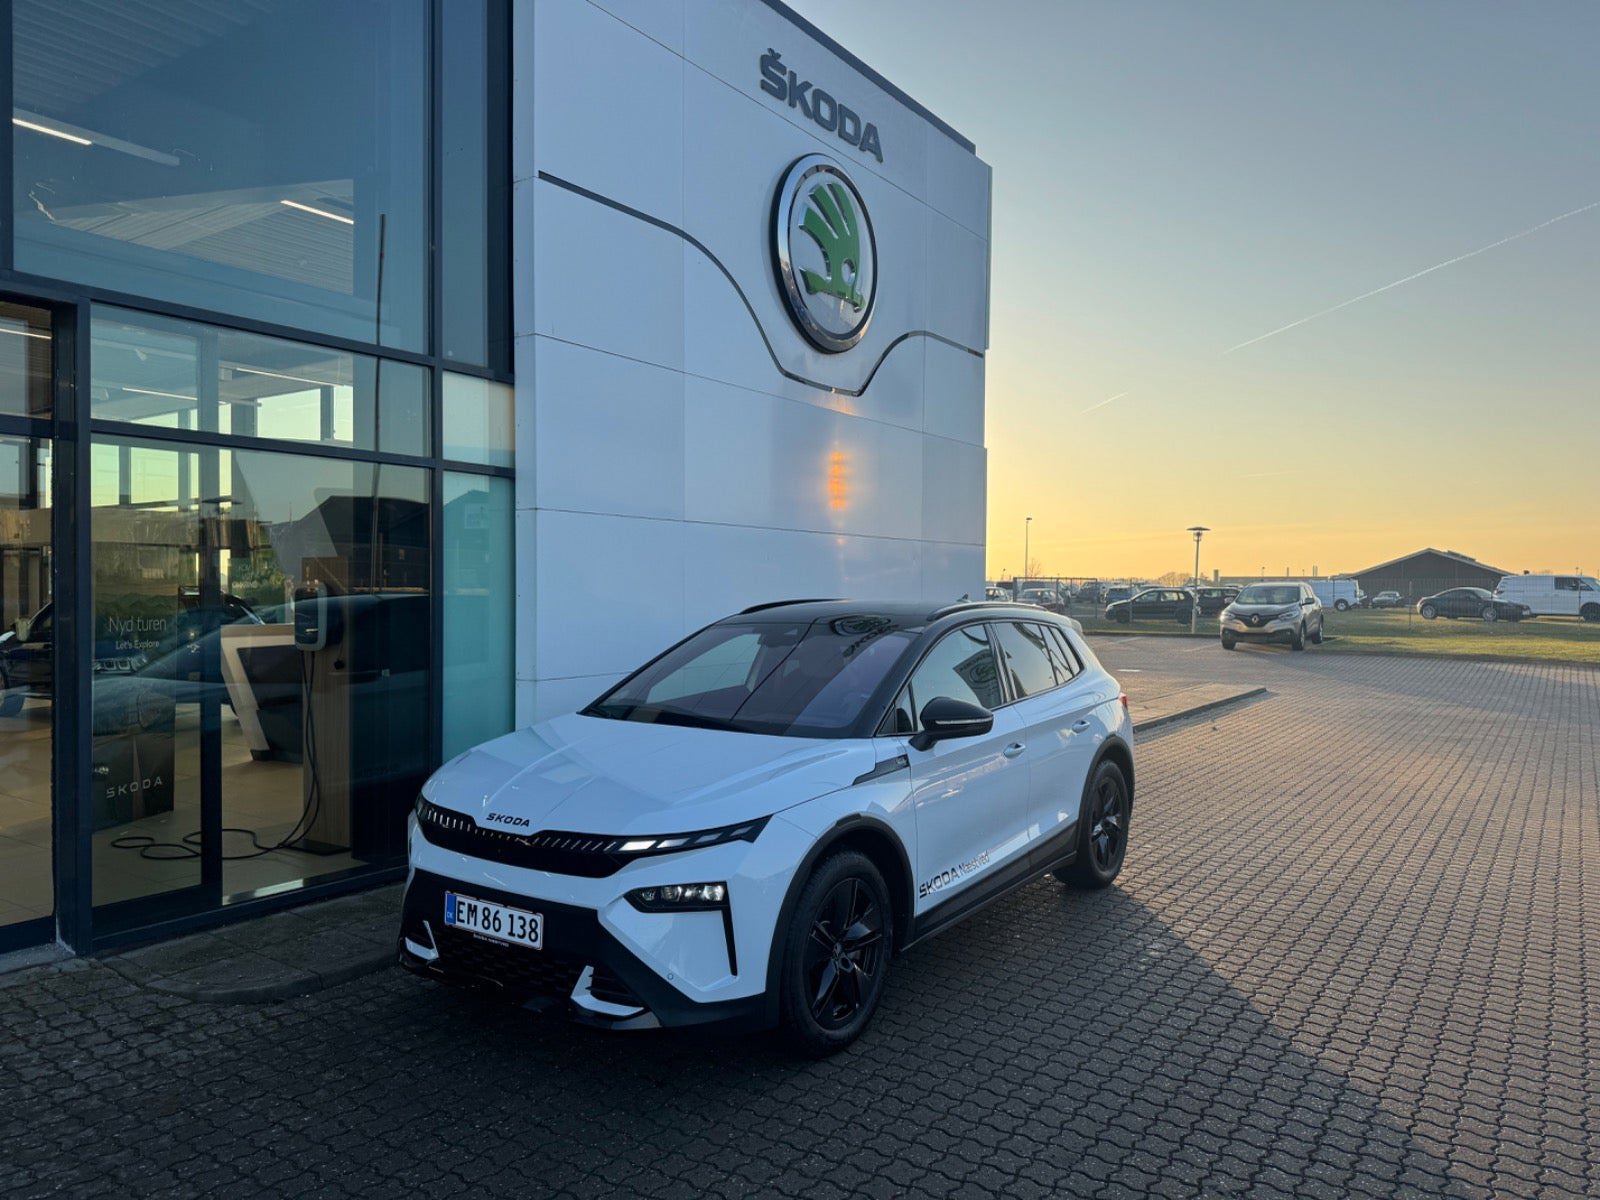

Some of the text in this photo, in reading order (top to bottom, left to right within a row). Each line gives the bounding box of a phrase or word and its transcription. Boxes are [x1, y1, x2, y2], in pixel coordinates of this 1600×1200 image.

[760, 47, 884, 163] ŠKODA
[109, 616, 167, 636] Nyd turen
[456, 900, 478, 927] EM
[481, 906, 502, 933] 86
[507, 913, 539, 943] 138
